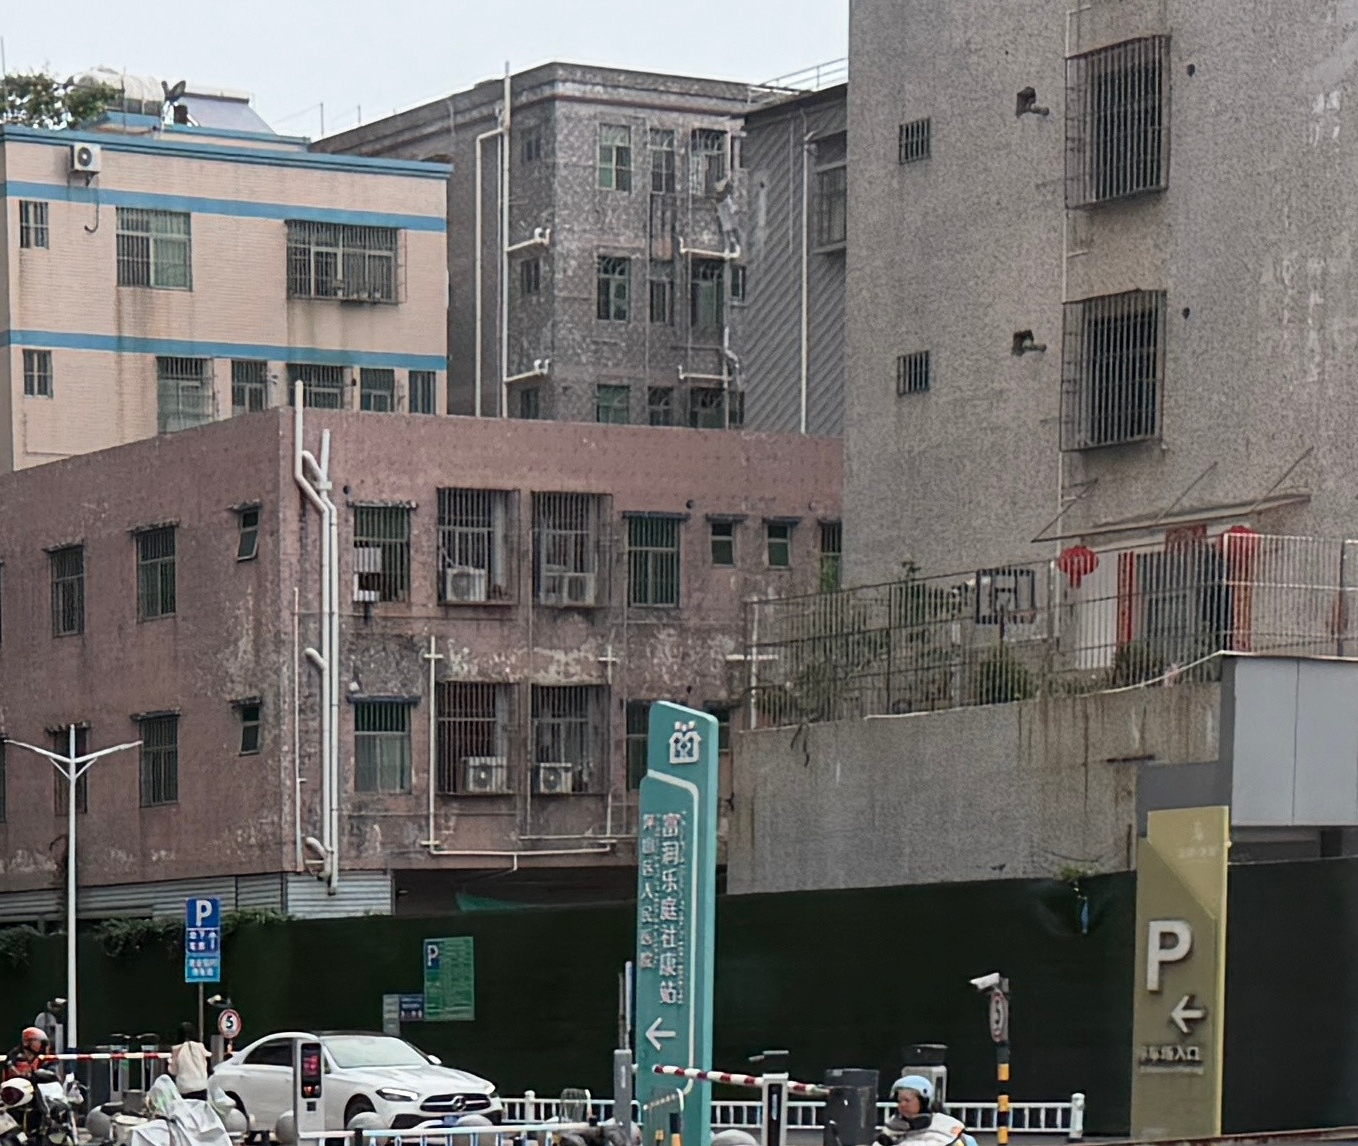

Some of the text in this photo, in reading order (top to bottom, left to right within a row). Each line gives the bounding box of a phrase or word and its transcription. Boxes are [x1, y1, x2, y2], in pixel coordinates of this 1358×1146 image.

[195, 899, 213, 927] P
[427, 944, 439, 967] P
[1146, 919, 1192, 992] P
[225, 1015, 234, 1029] 5
